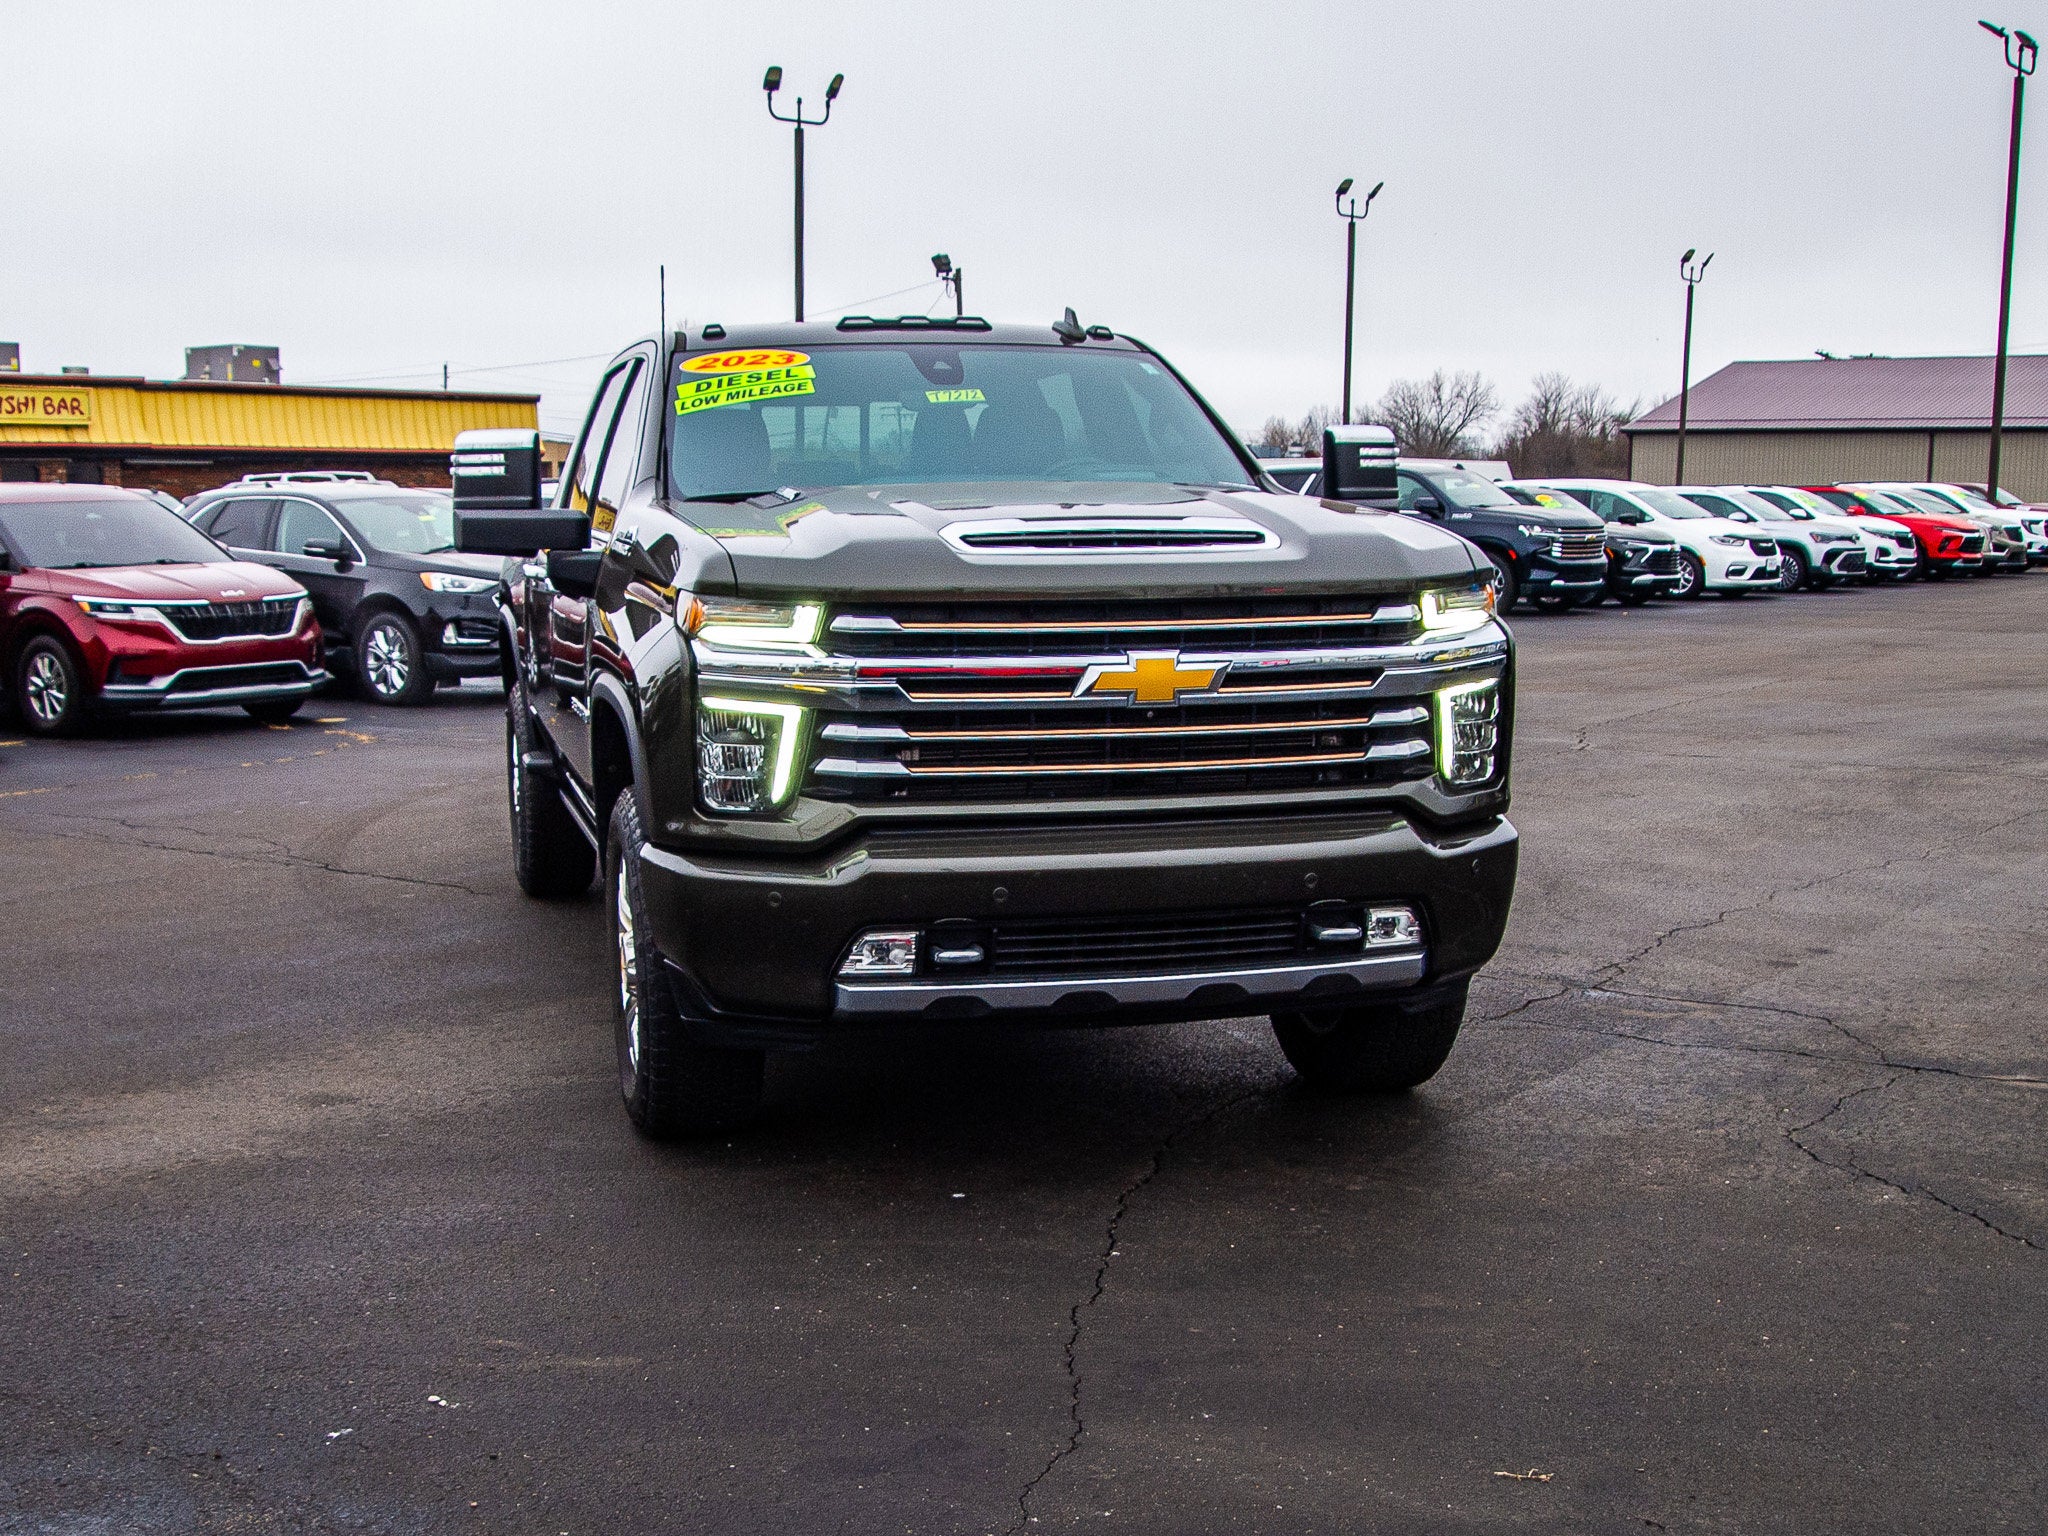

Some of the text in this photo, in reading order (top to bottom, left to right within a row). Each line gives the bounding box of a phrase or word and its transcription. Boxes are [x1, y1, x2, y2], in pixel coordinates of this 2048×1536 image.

[695, 353, 796, 370] 2023
[695, 368, 799, 393] DIESEL
[0, 395, 84, 415] SHI BAR
[680, 382, 809, 411] LOW MILEAGE
